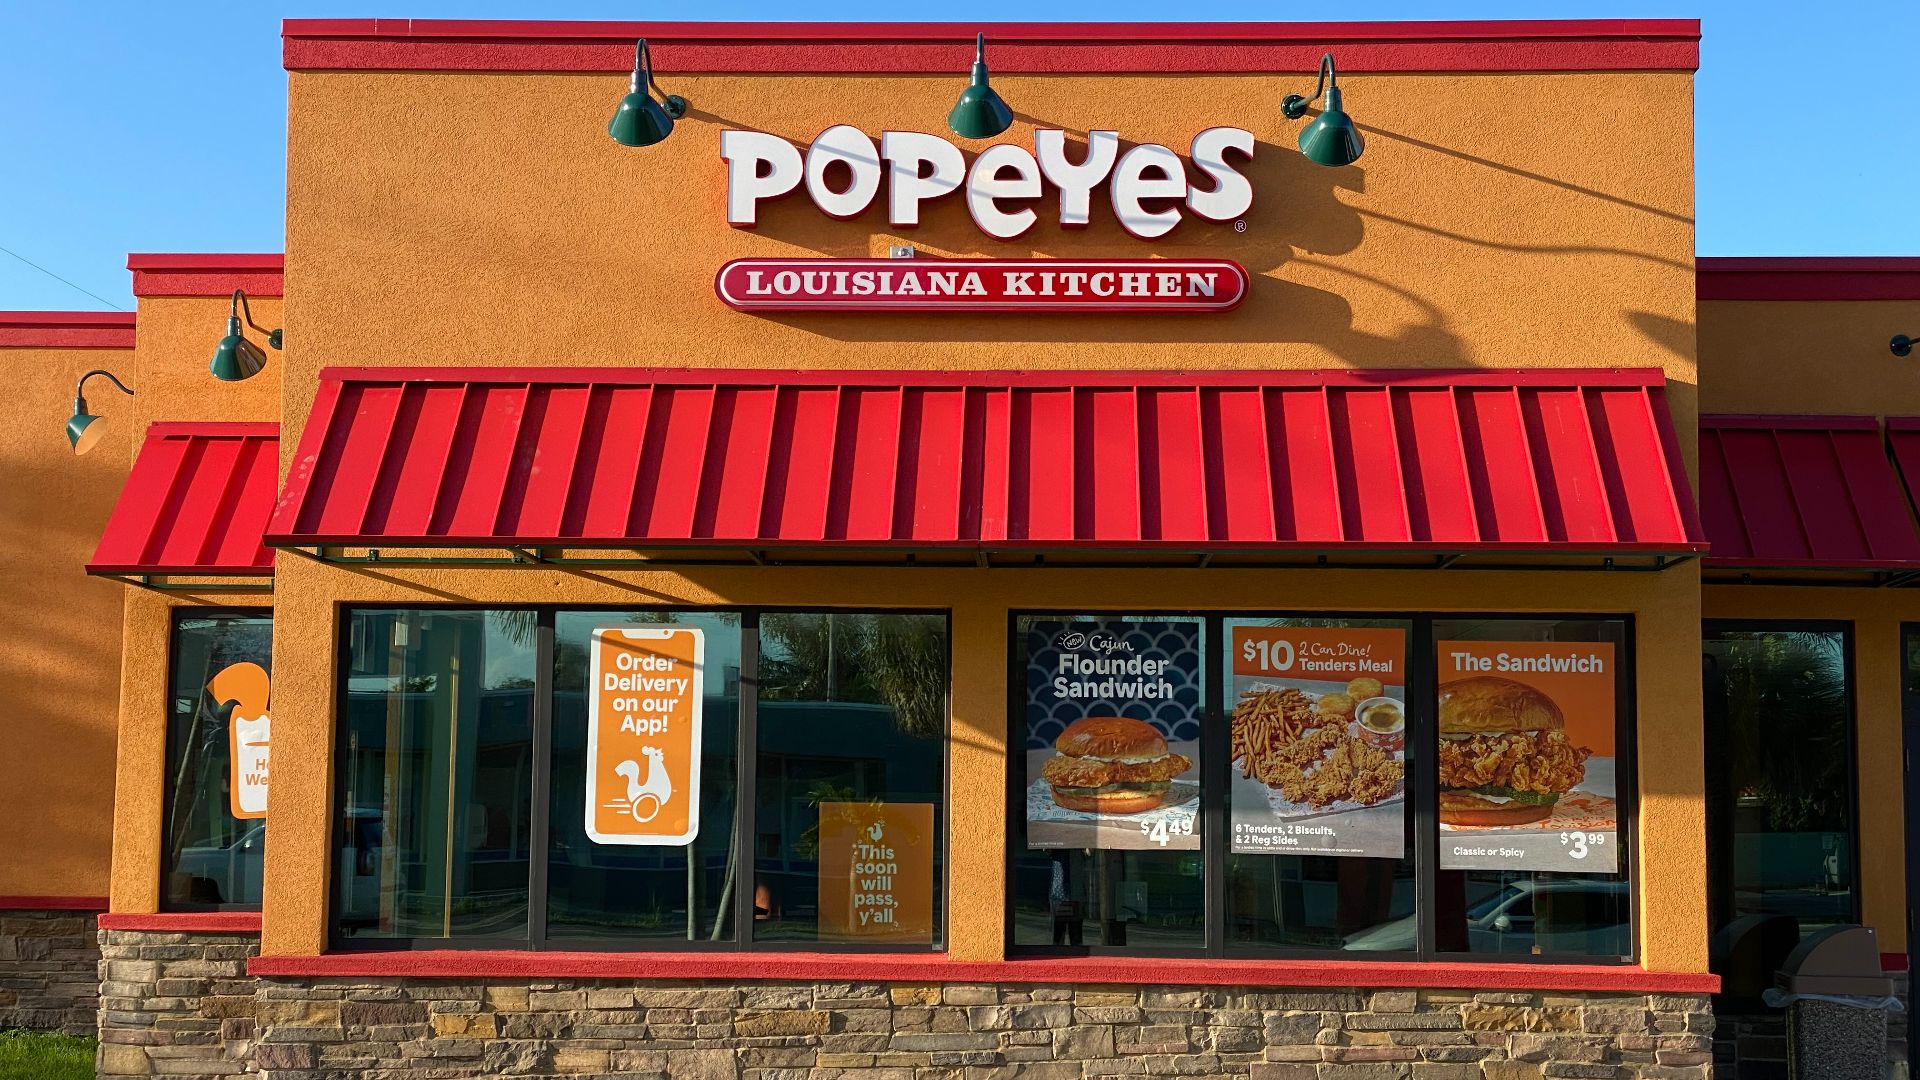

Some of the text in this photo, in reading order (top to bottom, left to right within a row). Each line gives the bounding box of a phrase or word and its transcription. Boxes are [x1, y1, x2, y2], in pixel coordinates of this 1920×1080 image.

[745, 271, 1218, 297] LOUISIANA KITCHEN
[1089, 635, 1134, 655] Cajun
[616, 653, 678, 671] Order
[1243, 639, 1371, 671] $10 2 Can Dine!
[1451, 652, 1603, 673] The Sandwich
[1059, 653, 1170, 675] Flounder
[1299, 658, 1393, 672] Tenders Meal
[604, 673, 688, 696] Delivery
[1053, 677, 1173, 698] Sandwich
[612, 697, 678, 713] on our
[620, 714, 668, 736] App!
[1235, 824, 1336, 837] 6 Tenders, 2 Biscuits,
[1235, 835, 1298, 846] & 2 Reg Sides
[858, 844, 895, 860] This
[1453, 846, 1486, 856] Classic
[1499, 847, 1525, 859] Spicy
[855, 862, 898, 875] soon
[861, 876, 892, 891] will
[854, 894, 899, 909] pass,
